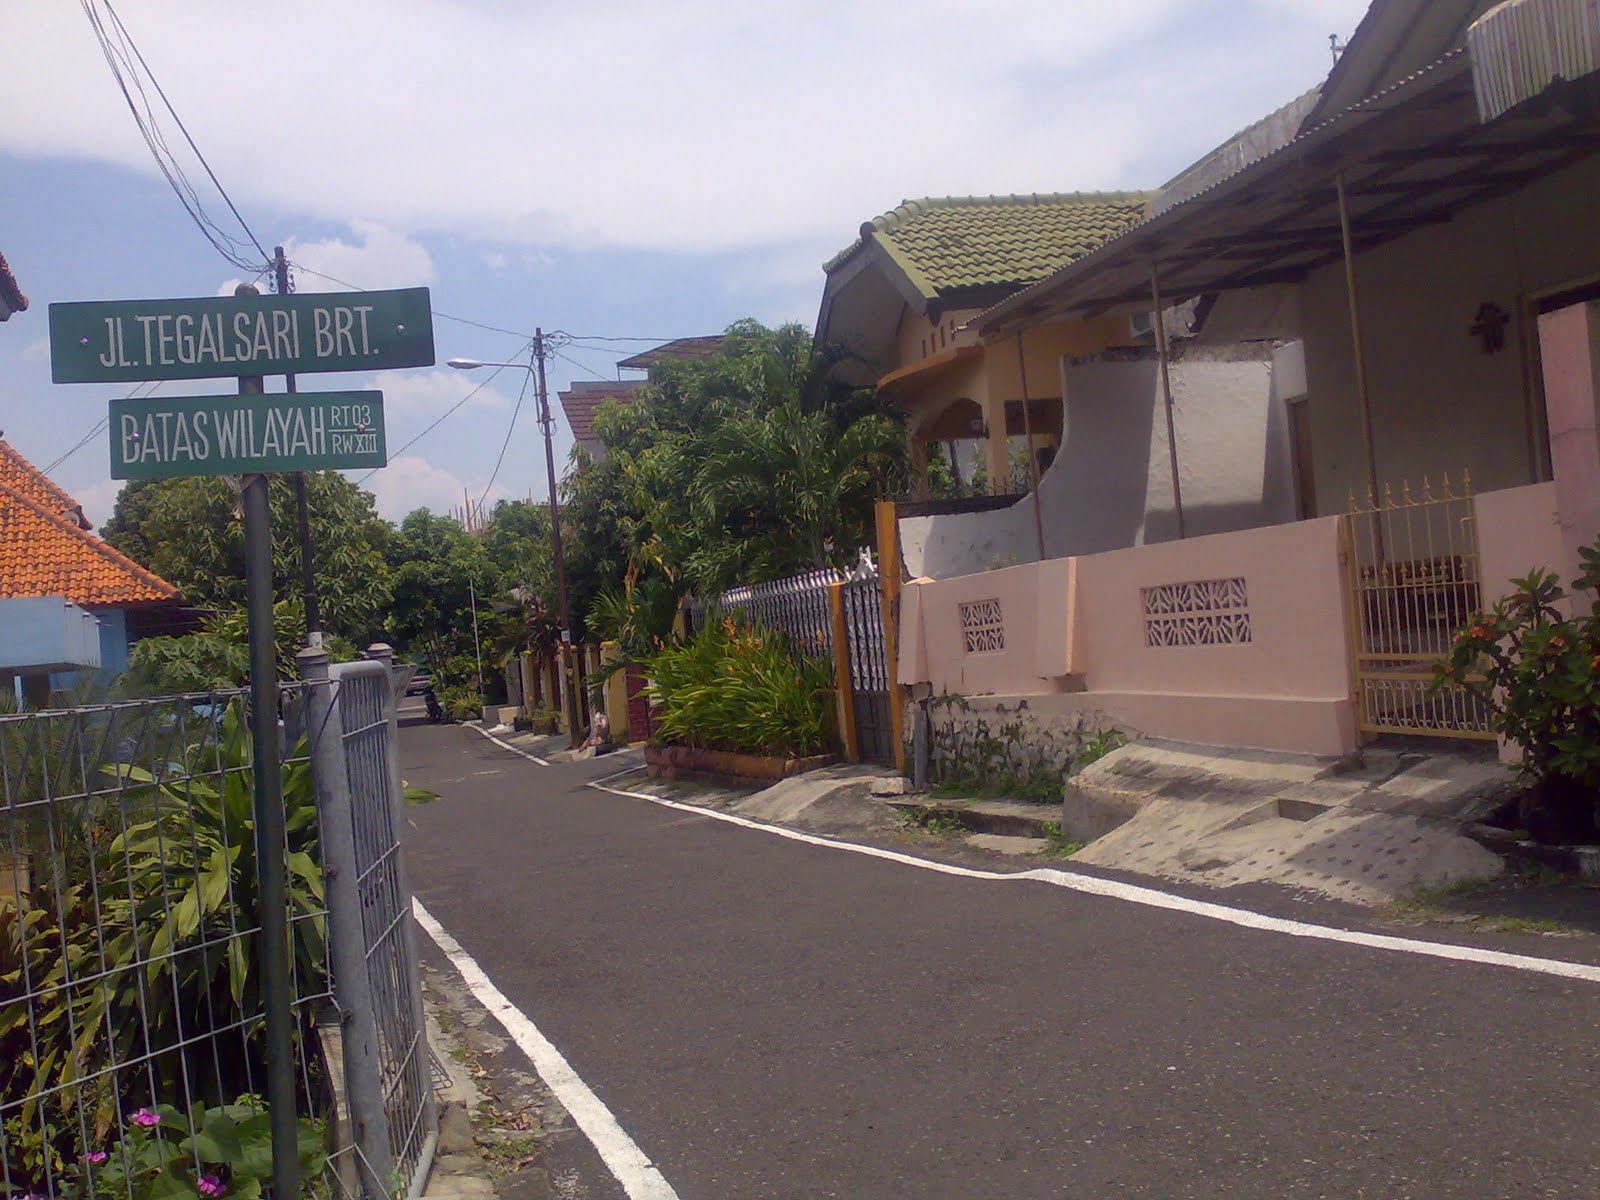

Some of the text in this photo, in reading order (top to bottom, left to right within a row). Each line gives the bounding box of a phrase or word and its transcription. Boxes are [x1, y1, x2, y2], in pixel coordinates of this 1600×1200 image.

[314, 305, 380, 358] BRT.
[121, 405, 326, 464] BATAS WILAYAH
